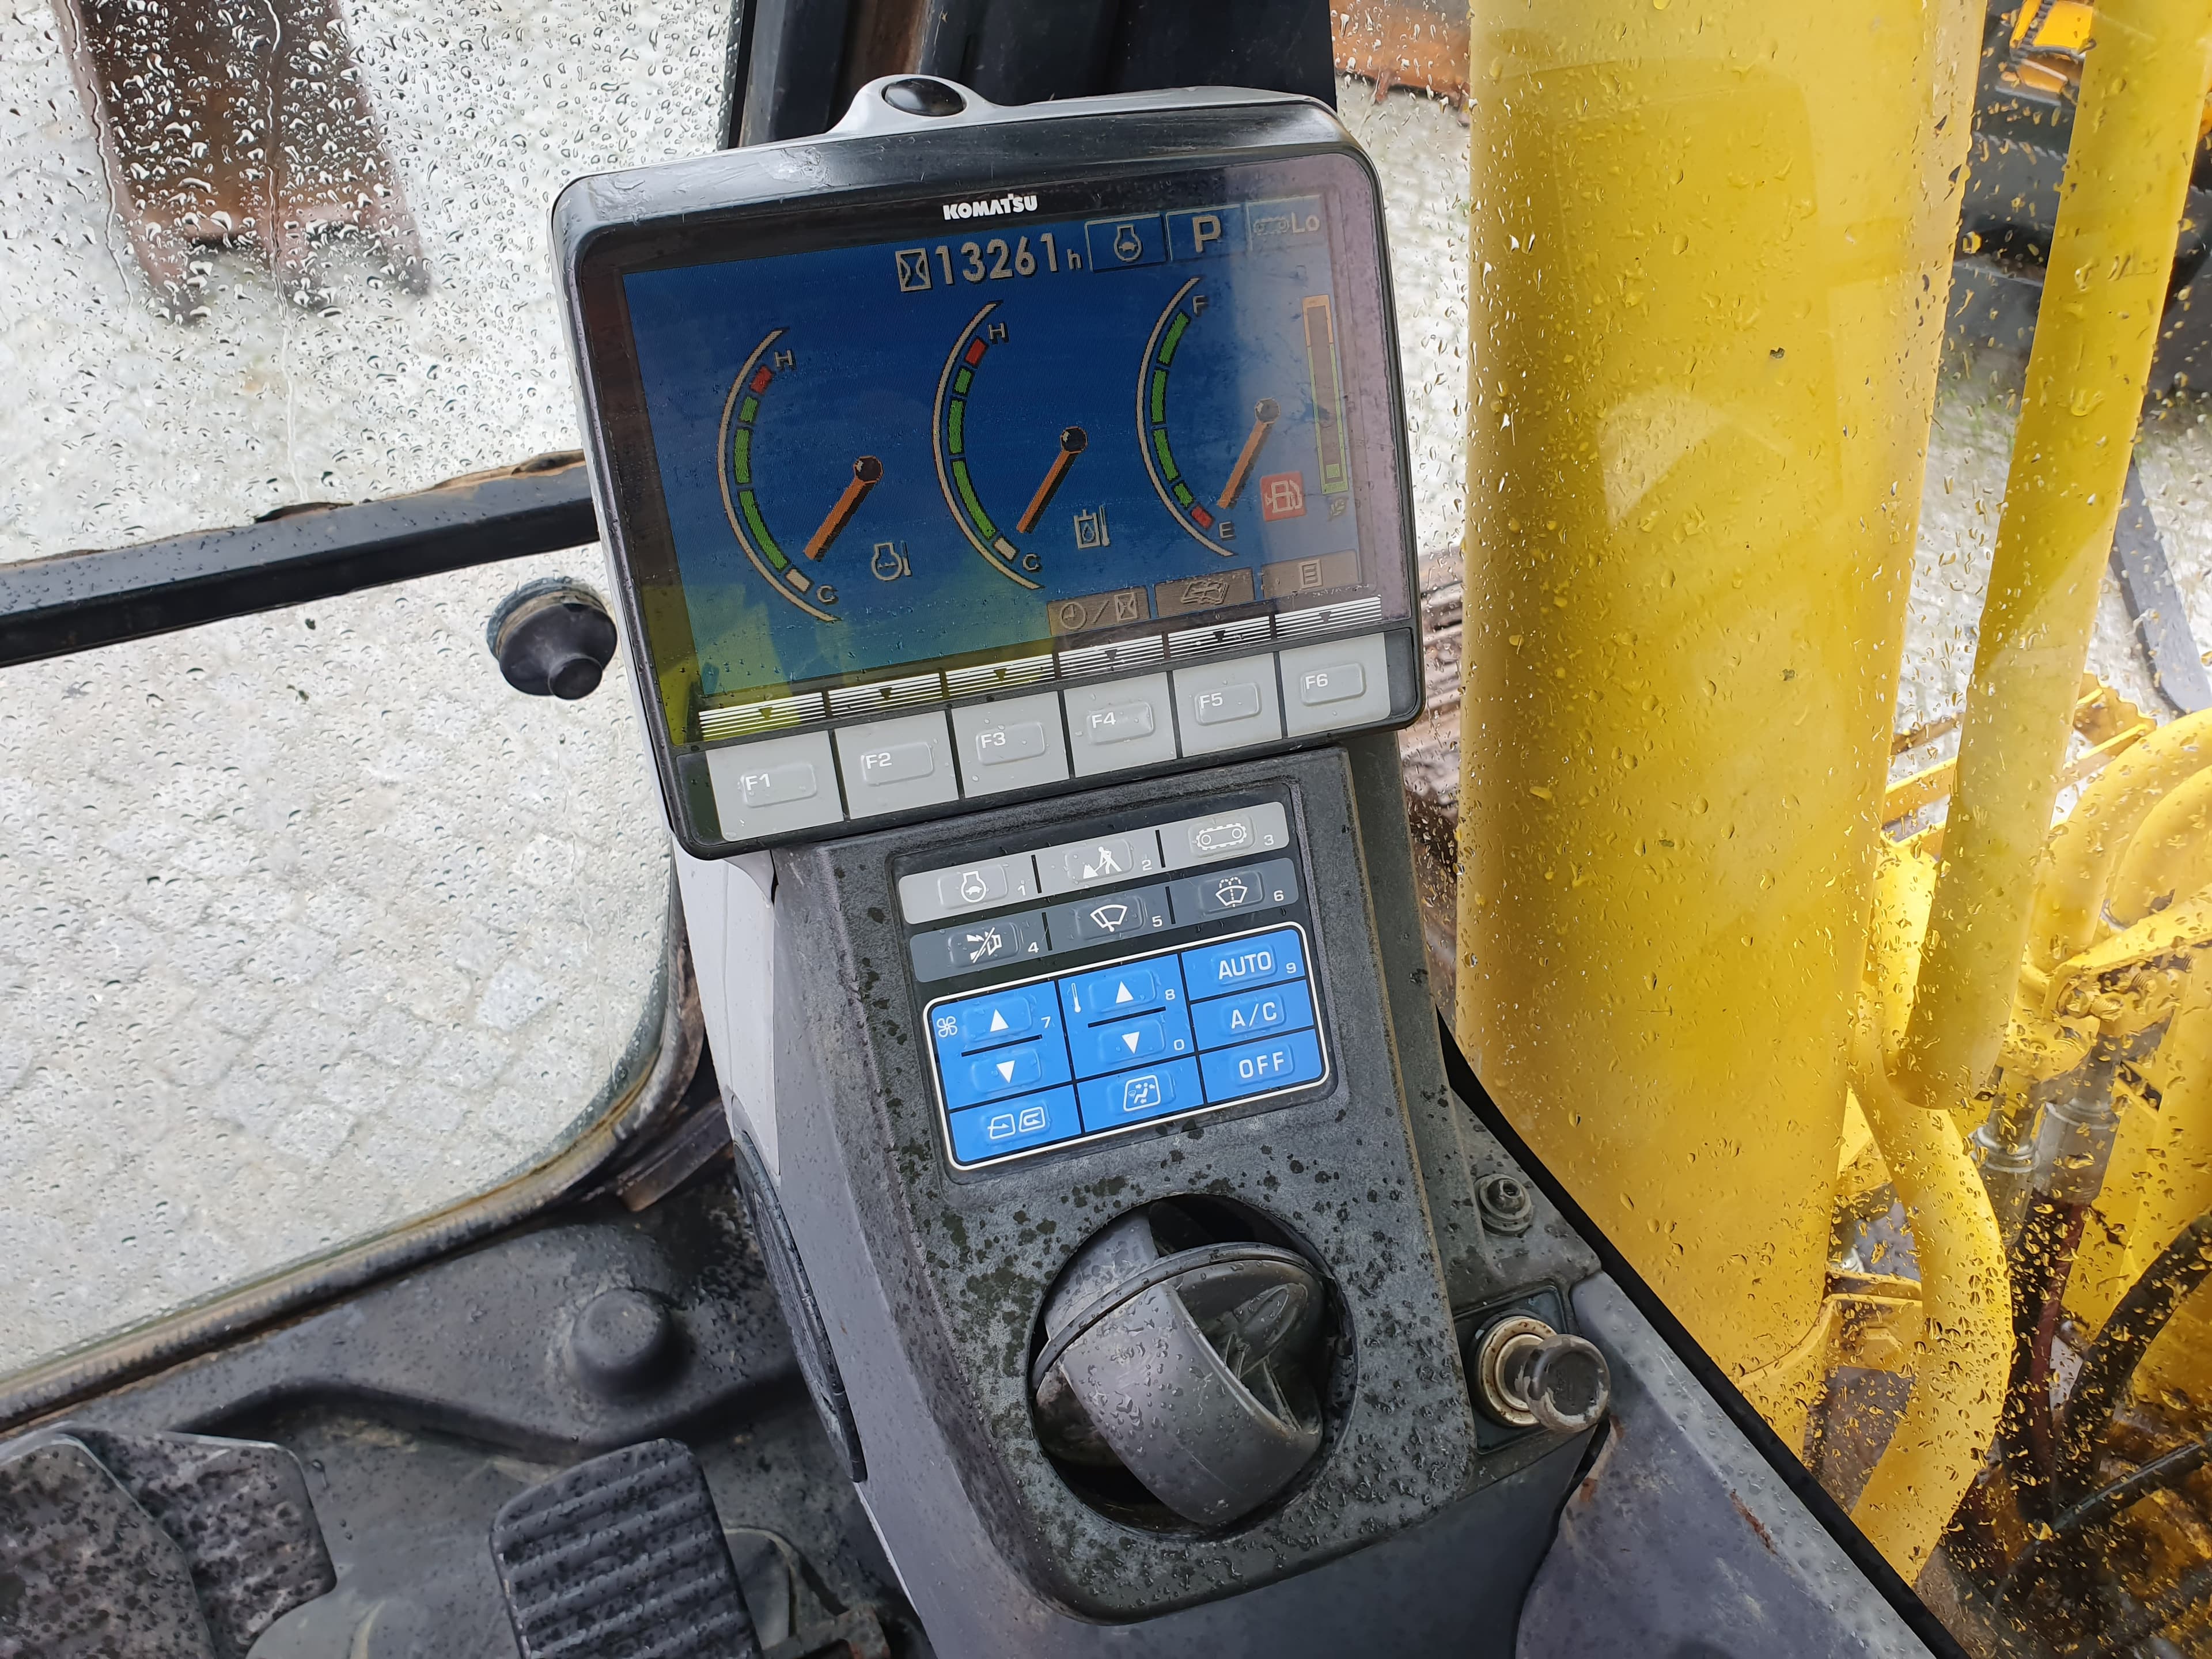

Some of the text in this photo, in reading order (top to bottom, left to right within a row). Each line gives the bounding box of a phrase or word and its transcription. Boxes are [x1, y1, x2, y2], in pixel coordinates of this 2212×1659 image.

[942, 194, 1038, 221] KOMATSU
[1191, 214, 1222, 252] P
[1291, 214, 1321, 234] Lo
[934, 232, 1082, 285] 13261 h
[1192, 294, 1209, 315] F
[987, 321, 1008, 343] H
[774, 349, 796, 369] H
[1218, 521, 1236, 540] E
[1022, 553, 1041, 572] C
[816, 585, 838, 604] C
[1304, 673, 1328, 690] F6
[1199, 693, 1224, 710] F5
[1091, 711, 1116, 729] F4
[980, 732, 1007, 749] F3
[865, 752, 892, 770] F2
[745, 772, 771, 791] F1
[1263, 834, 1275, 846] 3
[1141, 858, 1153, 871] 2
[1017, 884, 1028, 896] 1
[1273, 889, 1284, 902] 6
[1152, 915, 1163, 927] 5
[1027, 941, 1039, 953] 4
[1218, 950, 1272, 980] AUTO
[1285, 962, 1297, 975] 9
[1164, 988, 1176, 1001] 8
[1041, 1016, 1052, 1029] 7
[1230, 1001, 1278, 1029] A/C
[1173, 1038, 1185, 1051] 0
[1238, 1050, 1285, 1079] OFF
